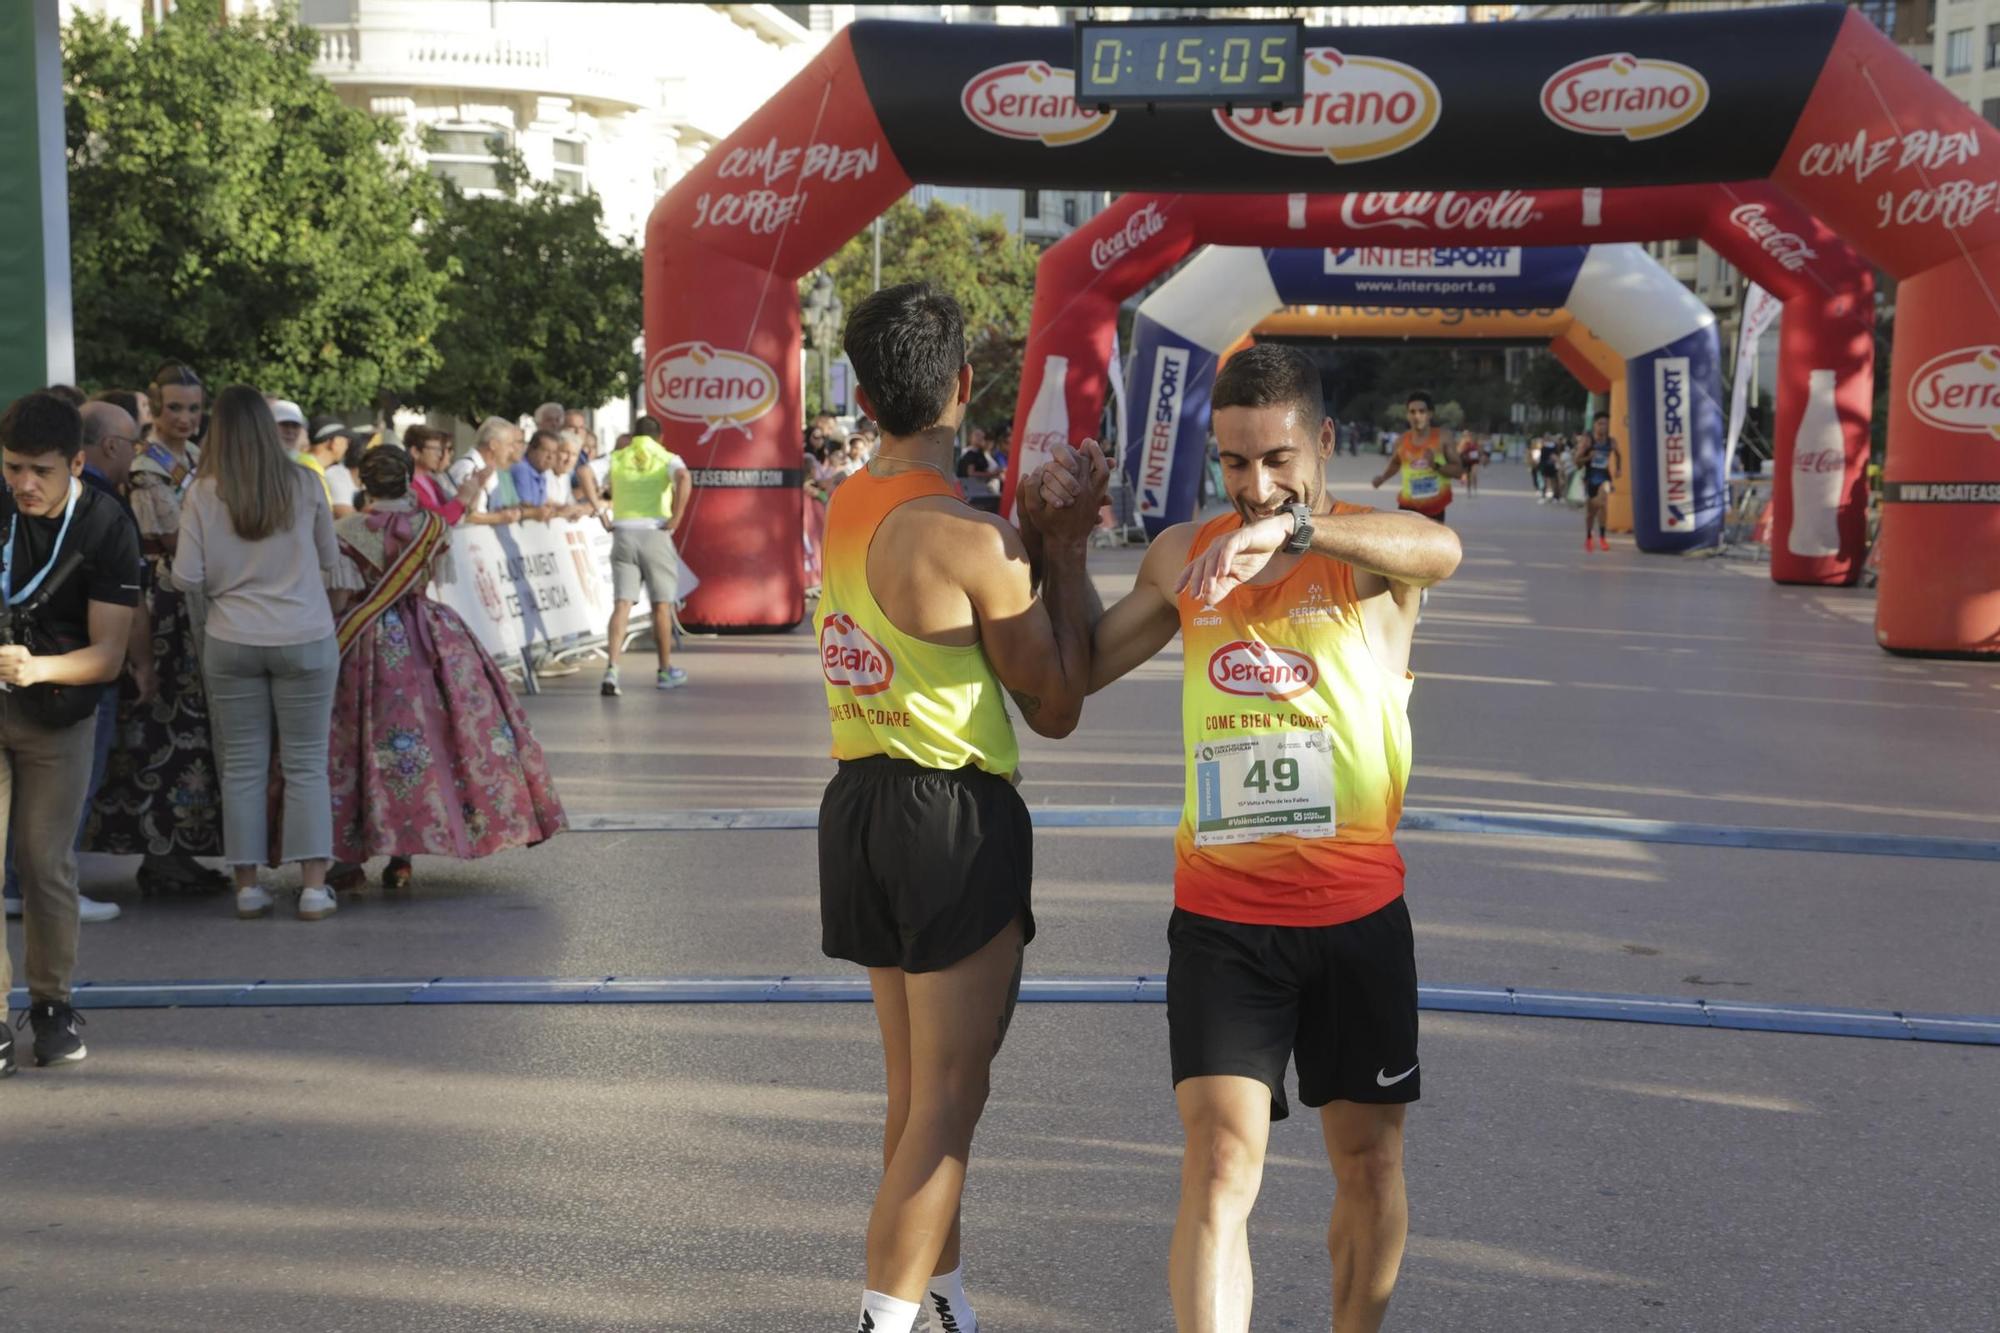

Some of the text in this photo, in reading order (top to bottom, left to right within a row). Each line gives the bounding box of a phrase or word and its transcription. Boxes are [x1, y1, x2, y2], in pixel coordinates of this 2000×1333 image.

[1091, 38, 1287, 84] 0:15:05
[1562, 80, 1690, 114] Serrano
[718, 137, 878, 187] COME BIEN
[1799, 128, 1980, 184] COME BIEN
[1359, 247, 1510, 267] INTERSPORT
[1356, 279, 1496, 295] www.intersport.es
[657, 367, 766, 400] Serrano
[1145, 356, 1180, 488] INTERSPORT
[1664, 368, 1687, 502] INTERSPORT
[506, 594, 524, 618] DE
[1218, 655, 1309, 684] Serrano
[1206, 715, 1236, 730] COME
[1241, 714, 1271, 729] BIEN
[1276, 714, 1285, 728] Y
[1243, 757, 1300, 794] 49
